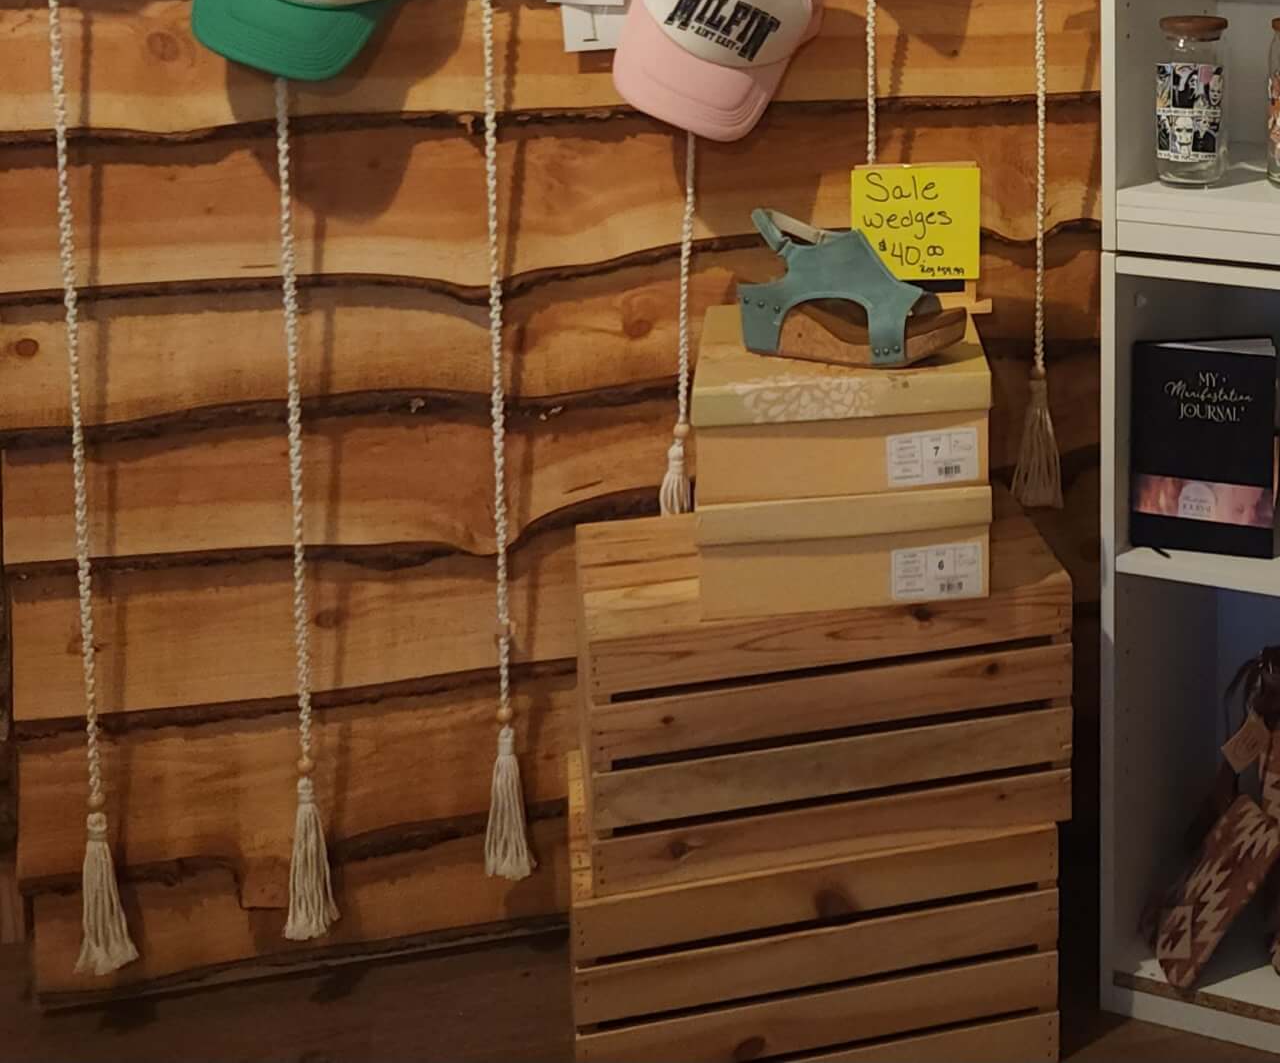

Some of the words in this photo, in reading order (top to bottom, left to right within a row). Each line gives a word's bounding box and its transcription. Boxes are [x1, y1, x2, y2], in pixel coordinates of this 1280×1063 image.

[865, 172, 939, 203] Sale
[1198, 372, 1219, 387] MY
[1164, 381, 1254, 403] Manifestation
[1178, 403, 1241, 423] JOURNAL
